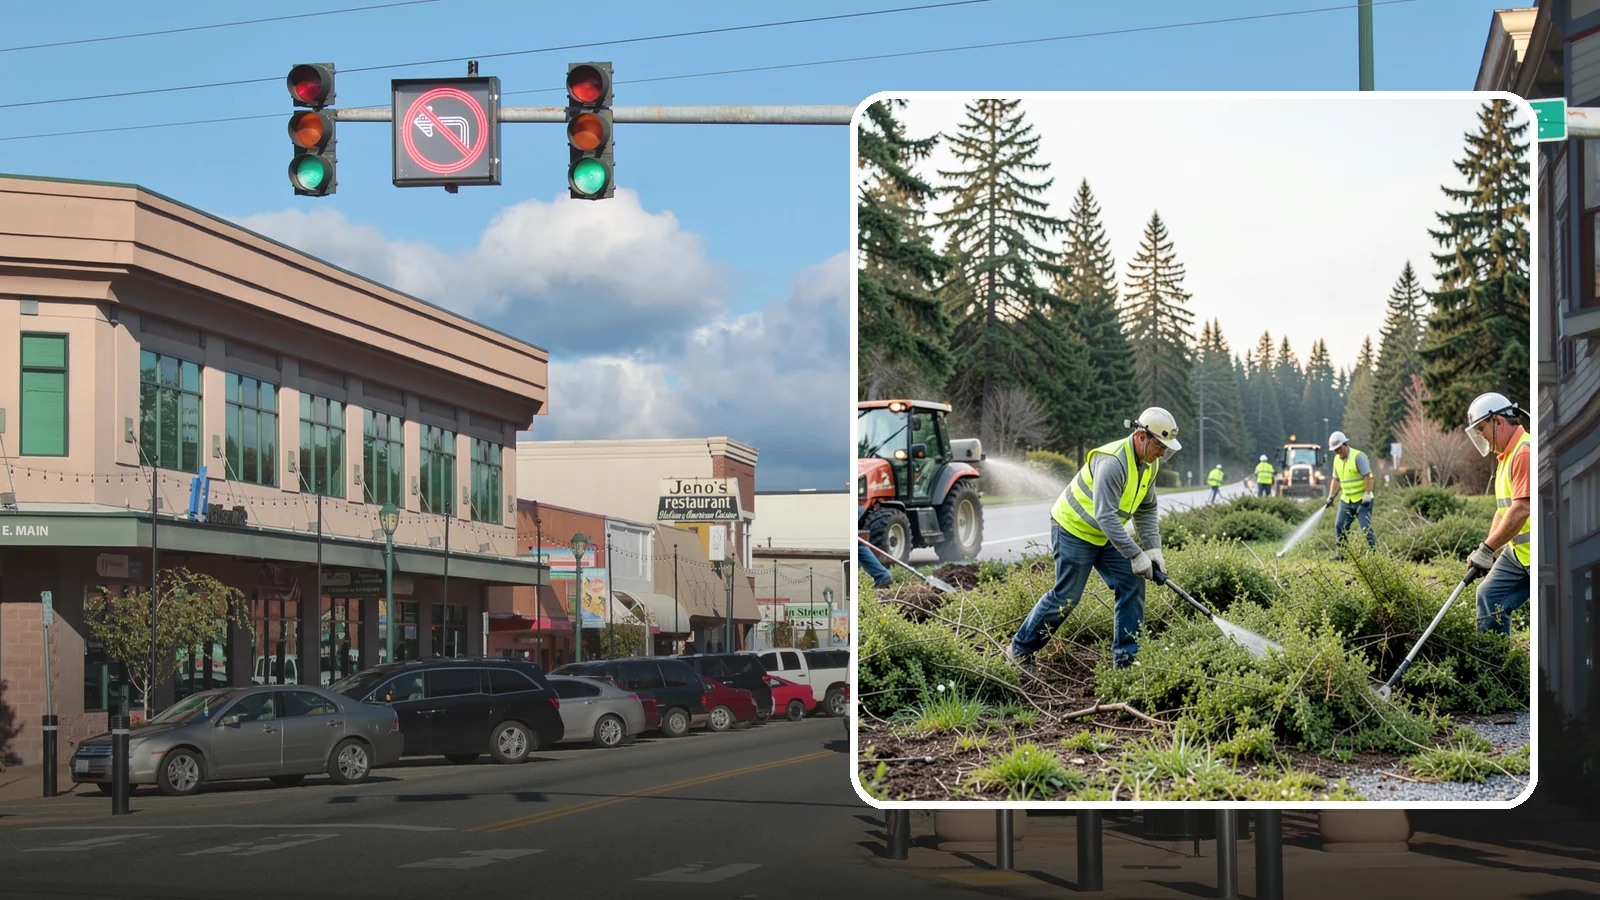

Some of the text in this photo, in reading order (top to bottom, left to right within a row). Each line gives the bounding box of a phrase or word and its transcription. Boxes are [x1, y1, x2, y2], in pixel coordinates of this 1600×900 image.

[669, 480, 727, 494] Jeno's
[665, 496, 731, 509] restaurant
[658, 510, 682, 519] Italian
[685, 509, 714, 519] American
[714, 509, 738, 519] Cuisine
[2, 525, 49, 536] E. MAIN
[797, 607, 828, 617] Street
[790, 618, 824, 627] lass
